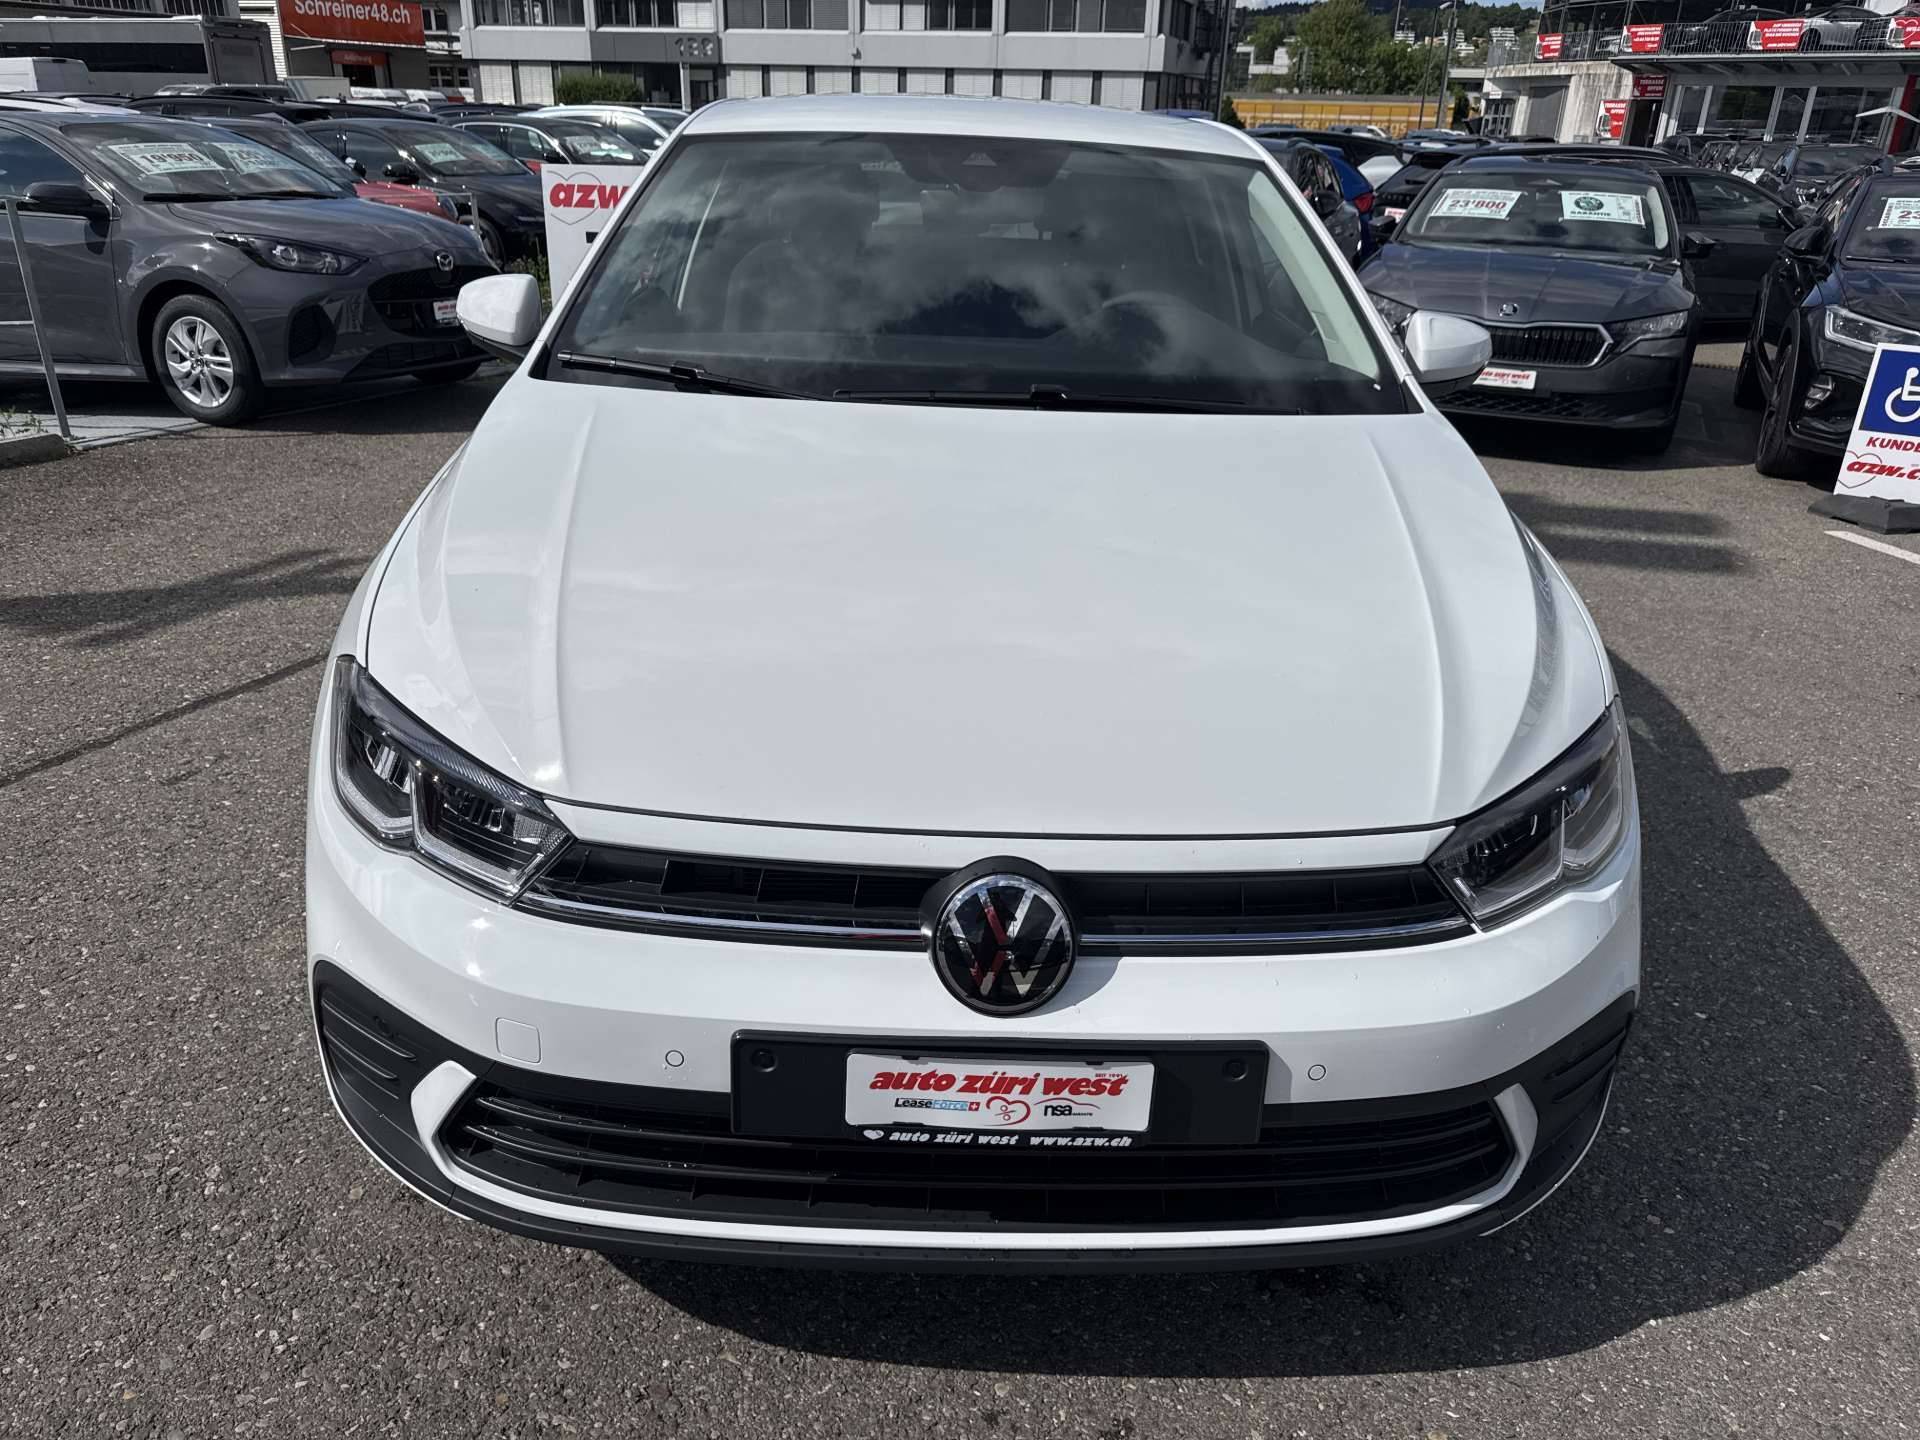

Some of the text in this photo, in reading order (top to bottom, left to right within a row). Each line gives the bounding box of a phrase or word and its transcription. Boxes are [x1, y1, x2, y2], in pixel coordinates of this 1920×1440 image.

[294, 0, 411, 24] Schreiner48.ch
[549, 183, 630, 209] azw
[1449, 199, 1507, 209] 23'800
[1847, 461, 1920, 480] azw.c
[869, 1069, 1129, 1096] auto züri west
[895, 1098, 968, 1111] LeaseForce
[1044, 1104, 1073, 1117] nsa
[889, 1131, 1133, 1148] auto züri west www.azw.ch
